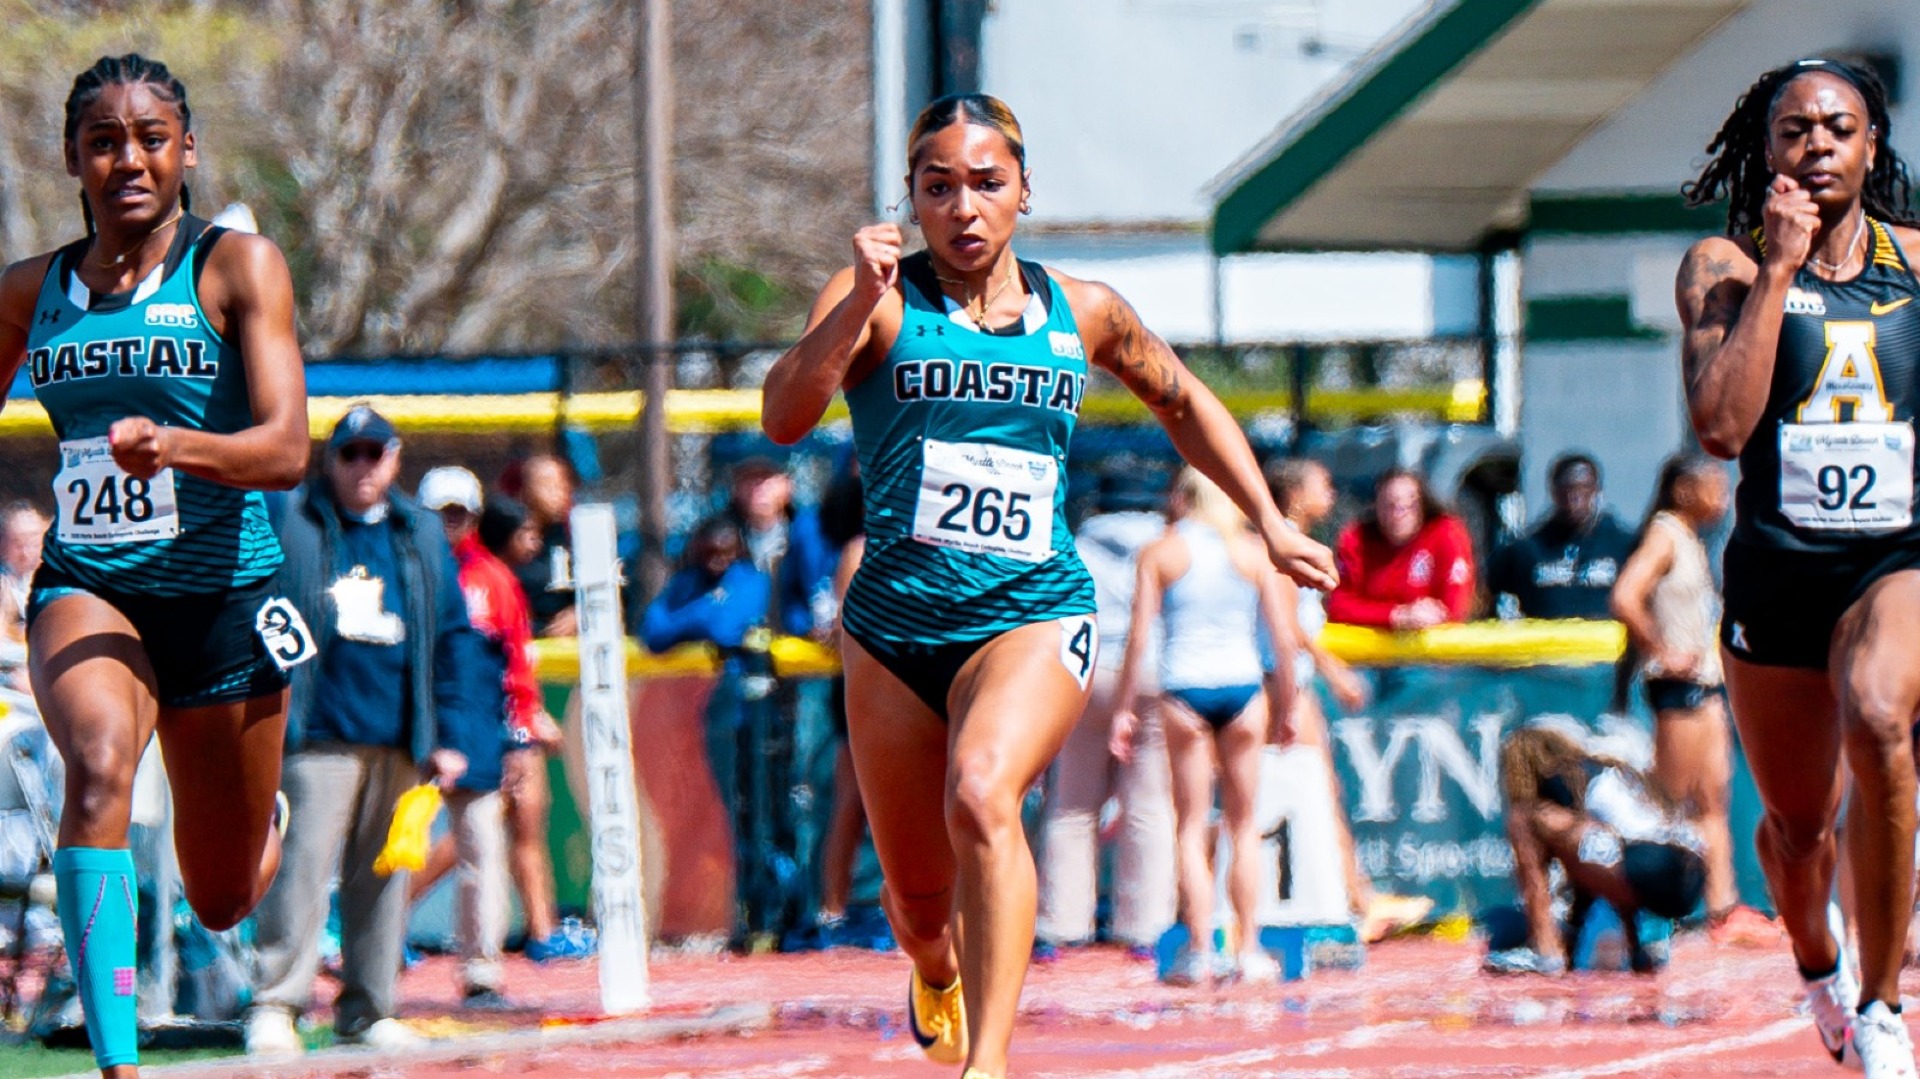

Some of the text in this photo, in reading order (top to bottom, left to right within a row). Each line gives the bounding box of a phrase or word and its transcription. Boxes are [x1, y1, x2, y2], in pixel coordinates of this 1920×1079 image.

[28, 336, 218, 388] OASTAL
[1796, 320, 1894, 423] A
[67, 474, 154, 526] 248
[936, 483, 1031, 541] 265
[1817, 464, 1876, 511] 92
[262, 605, 306, 662] 3
[1068, 620, 1092, 679] 4
[580, 582, 638, 936] FINISH
[1261, 817, 1292, 901] 1
